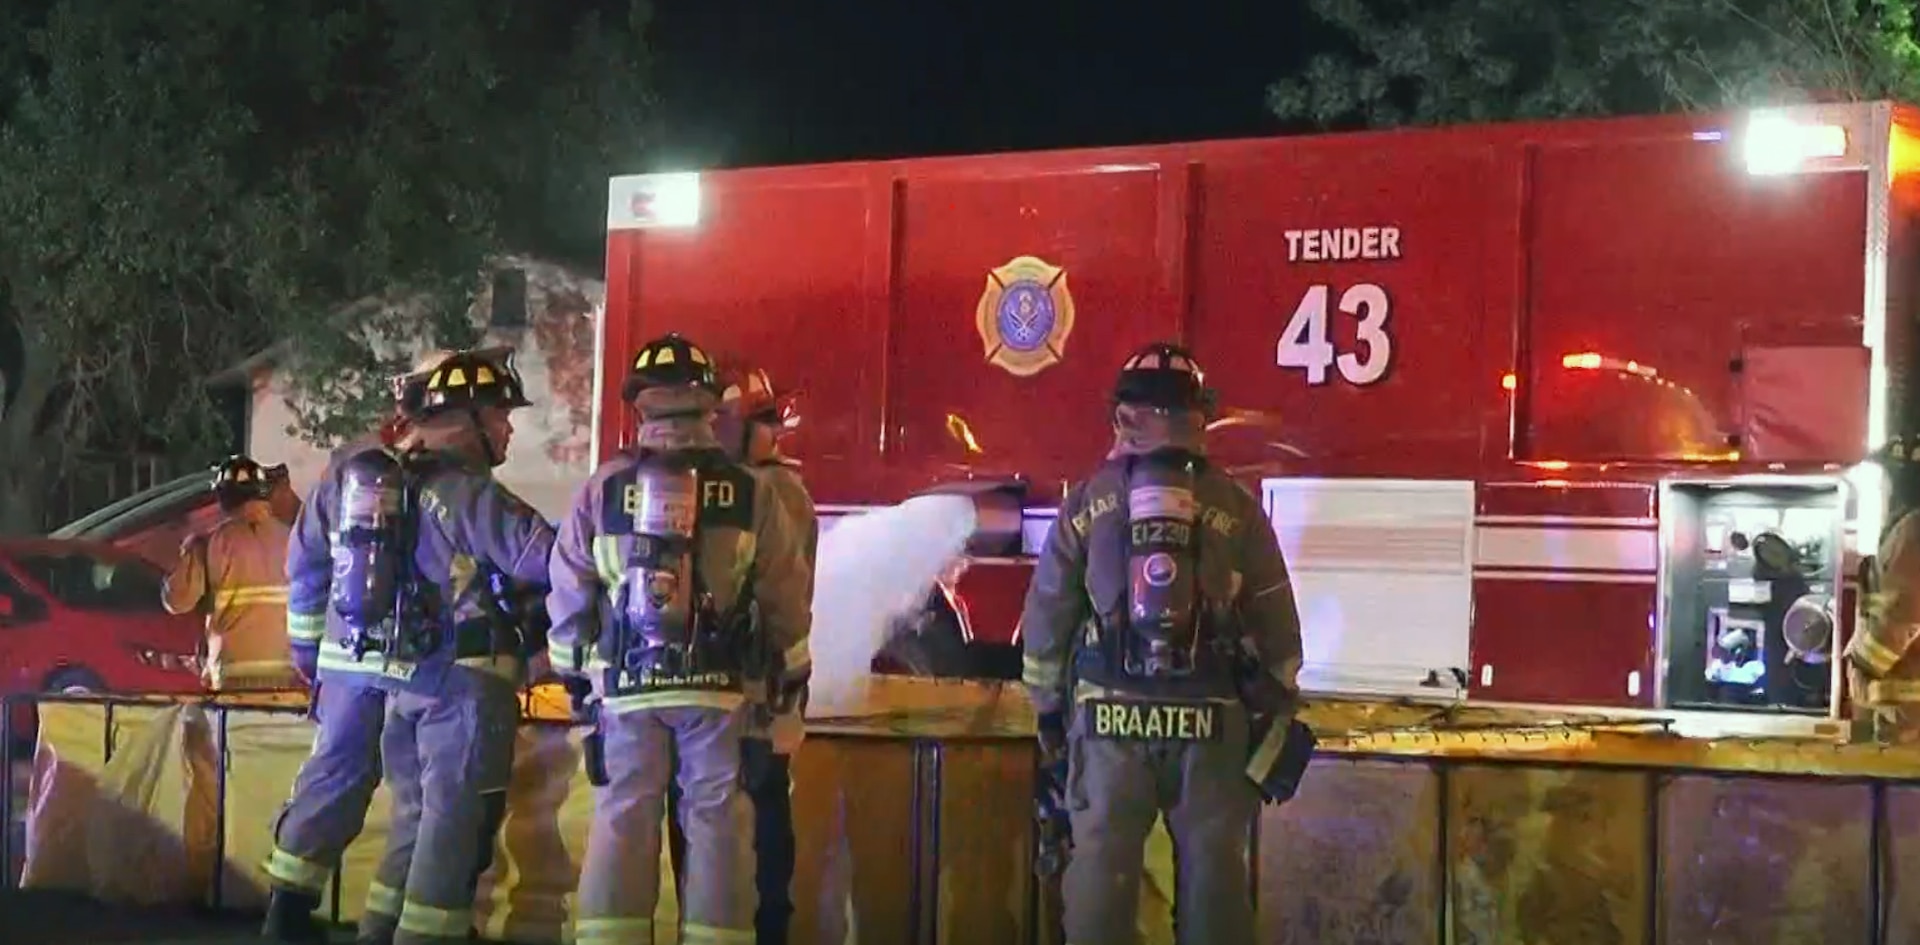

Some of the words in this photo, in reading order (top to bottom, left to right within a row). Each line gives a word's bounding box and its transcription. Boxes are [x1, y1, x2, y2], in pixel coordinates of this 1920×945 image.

[1284, 226, 1400, 261] TENDER
[1277, 283, 1391, 384] 43
[703, 481, 734, 508] FD
[1096, 703, 1212, 738] BRAATEN
